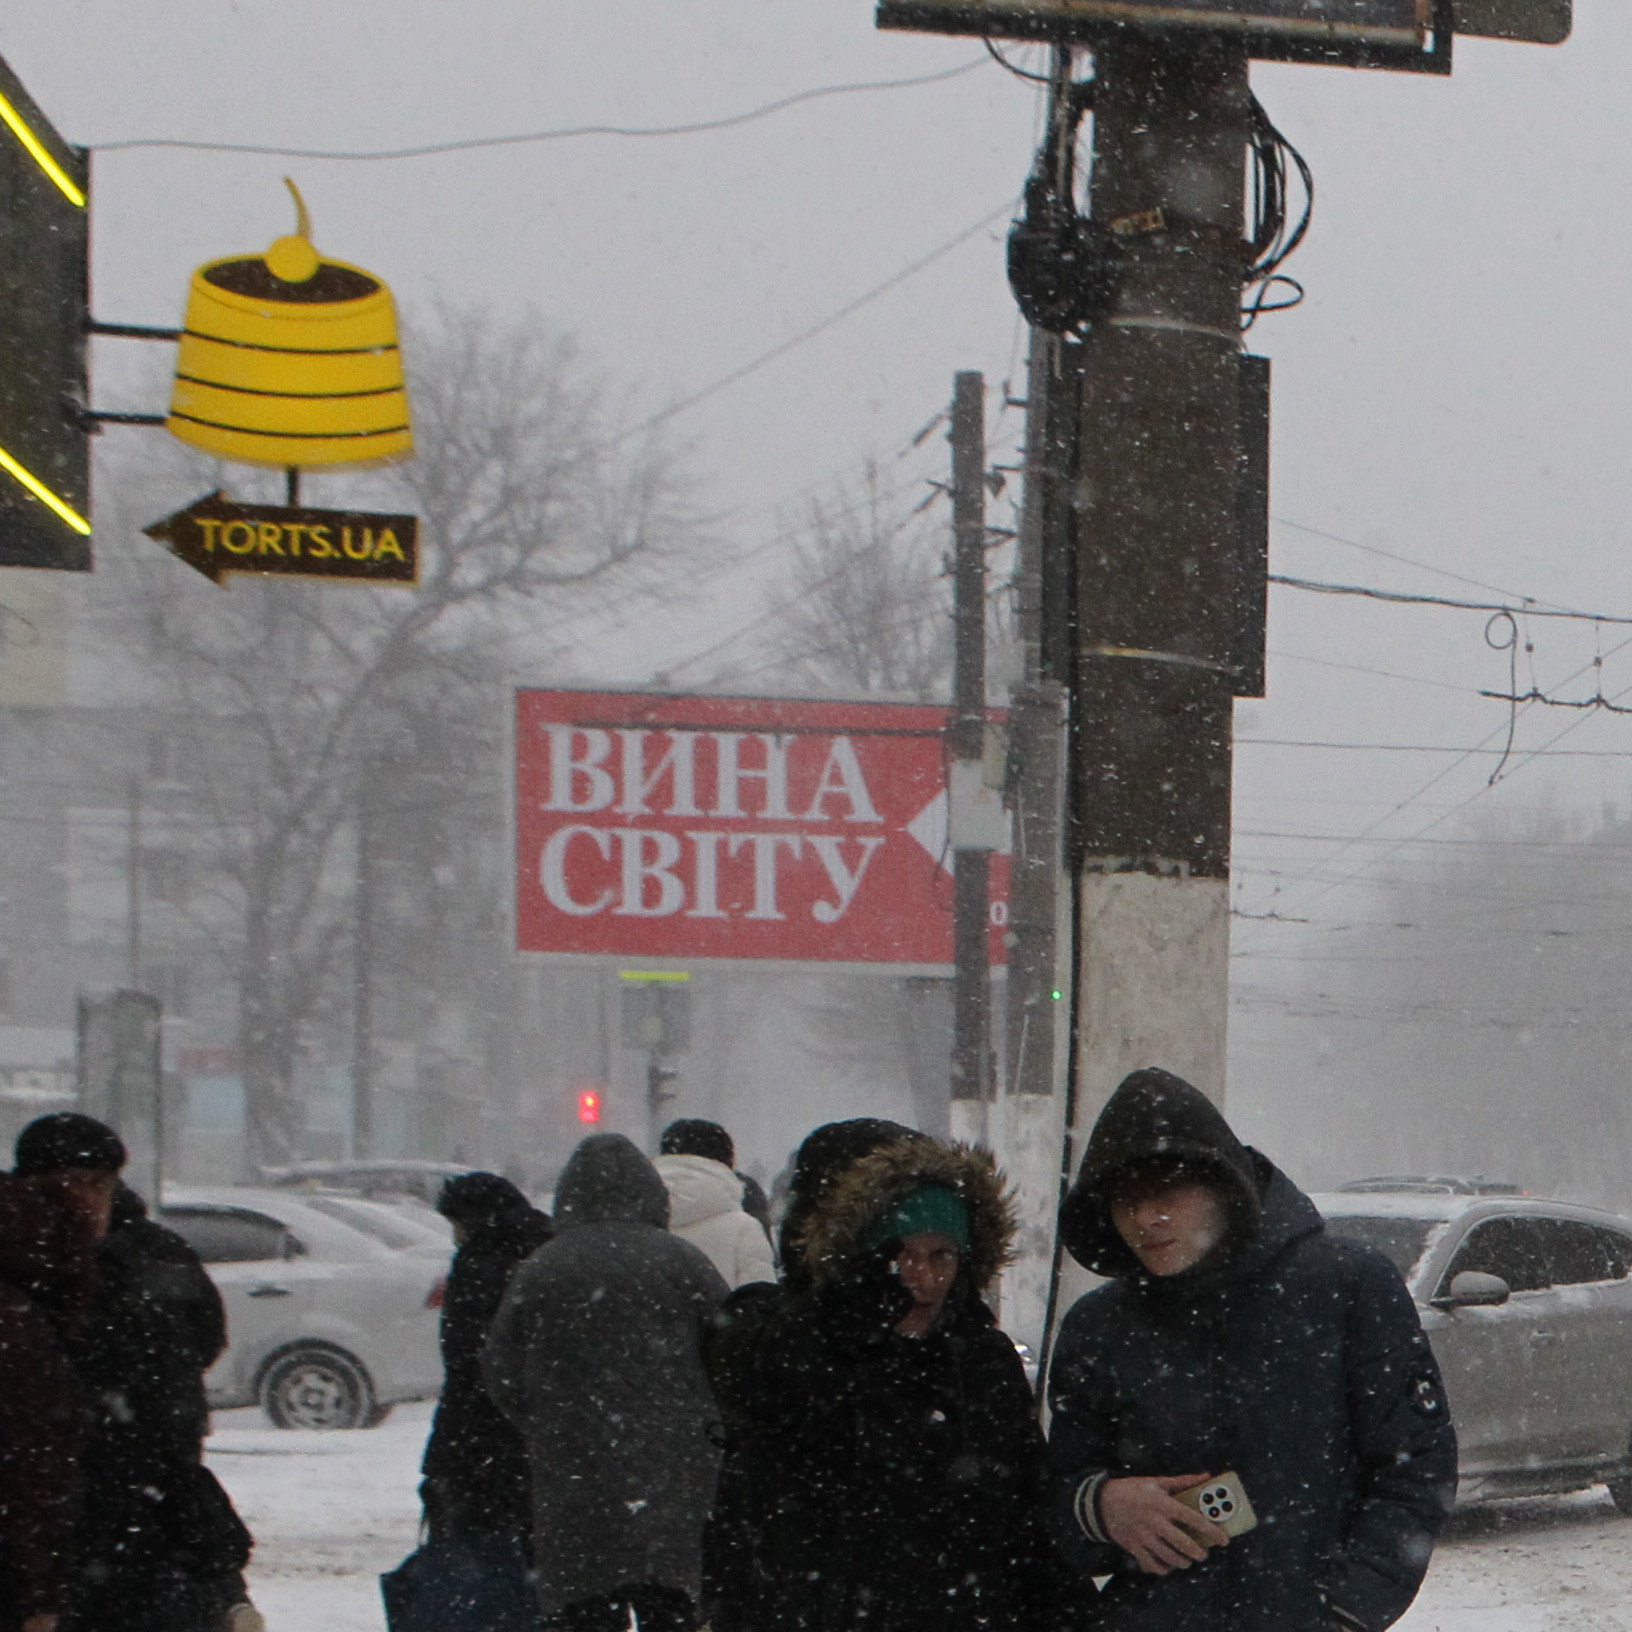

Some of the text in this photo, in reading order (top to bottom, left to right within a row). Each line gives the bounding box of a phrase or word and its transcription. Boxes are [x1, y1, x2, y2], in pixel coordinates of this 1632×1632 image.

[194, 517, 406, 562] TORTS.UA
[540, 722, 885, 823] ВИНА
[539, 824, 886, 922] СВІТУ
